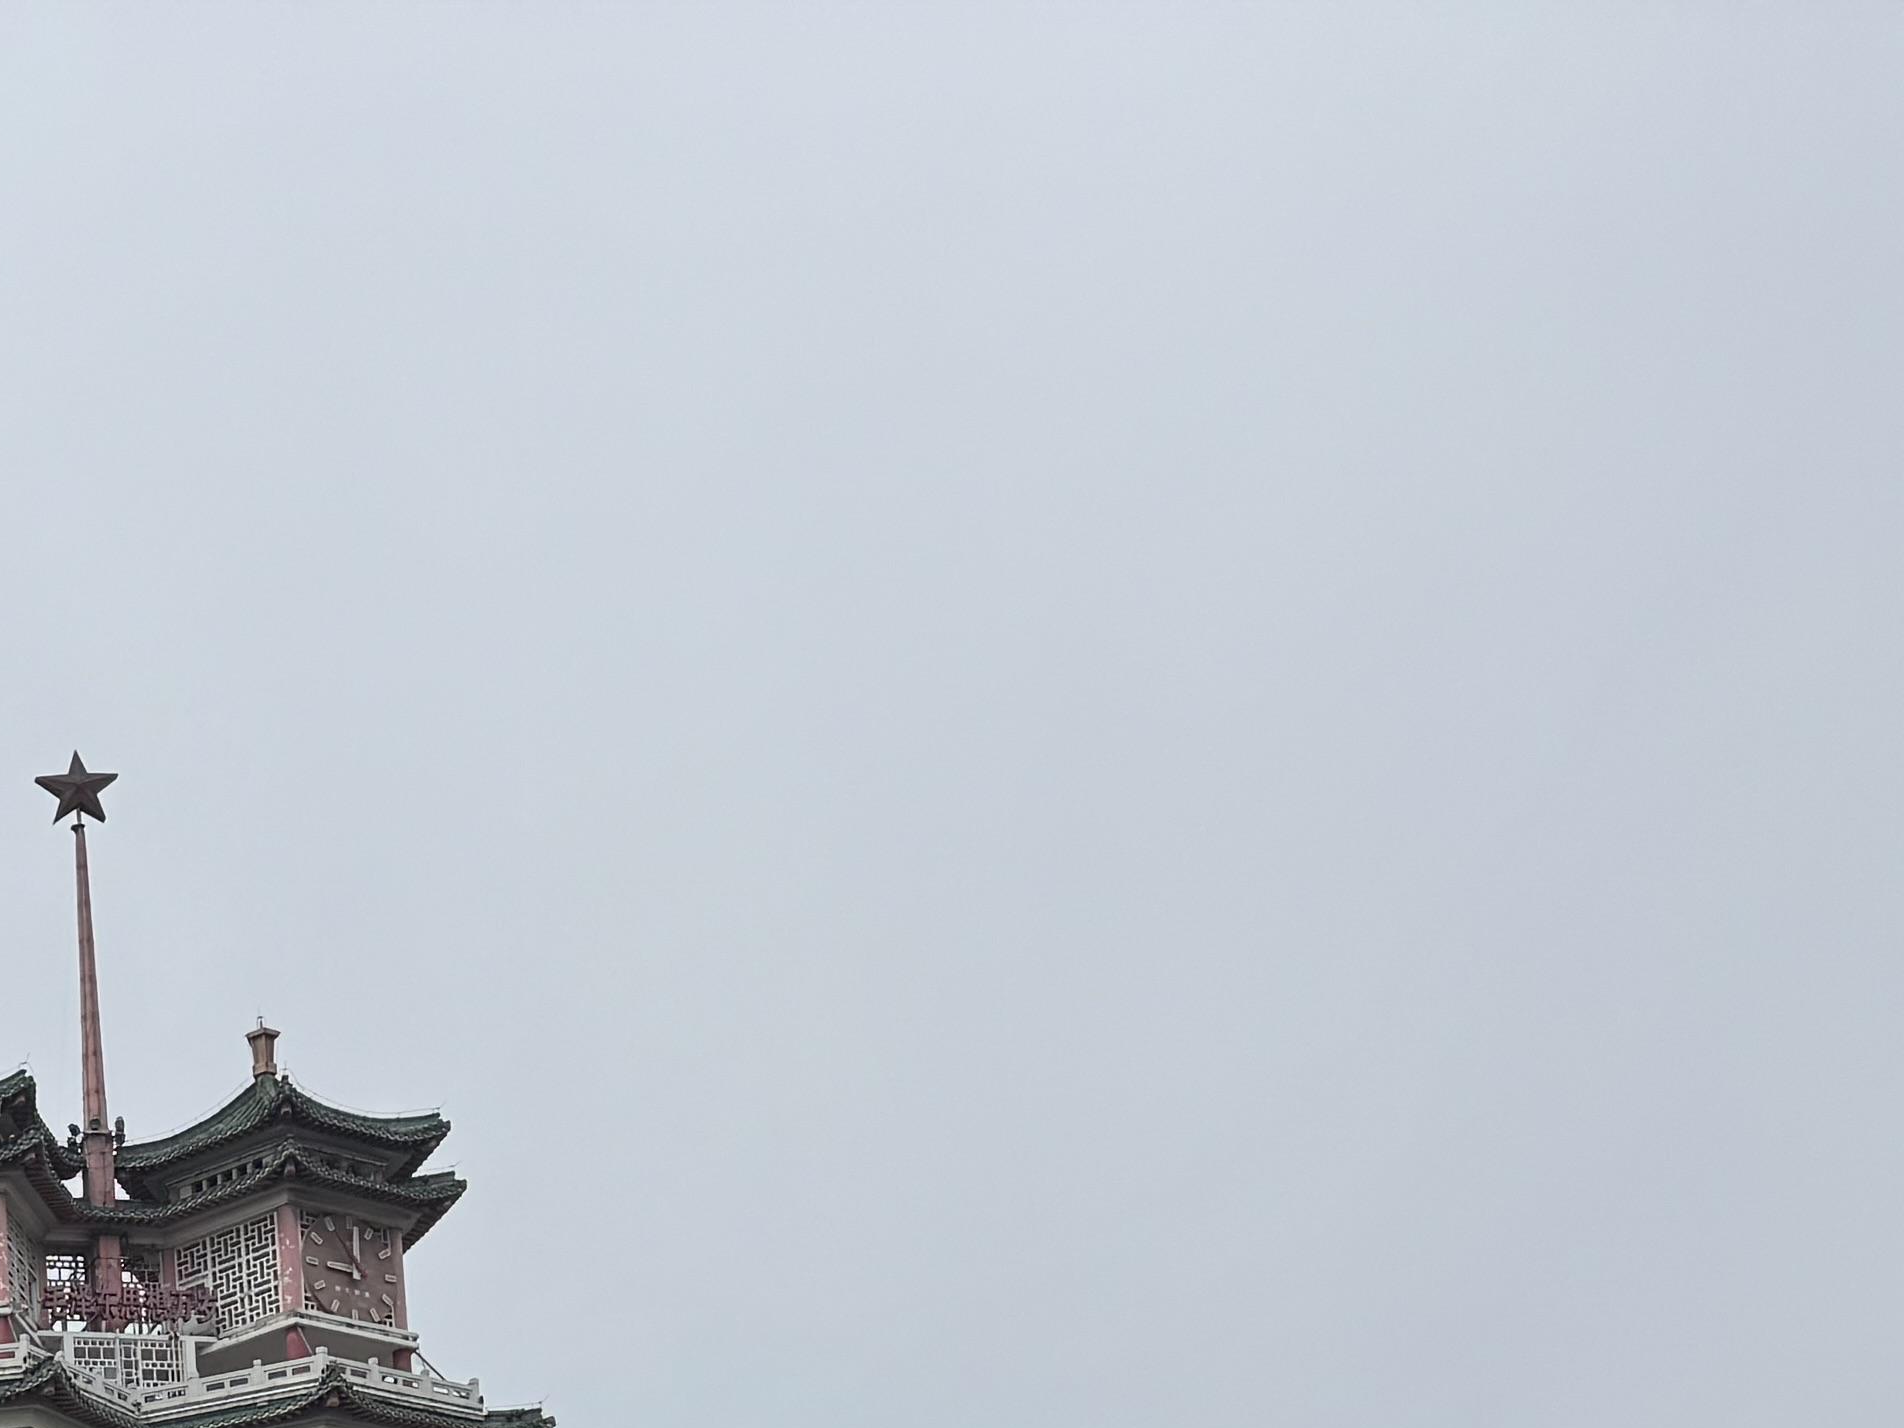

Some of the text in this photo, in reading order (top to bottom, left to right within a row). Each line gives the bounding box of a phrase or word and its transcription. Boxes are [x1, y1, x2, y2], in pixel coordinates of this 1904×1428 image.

[43, 1277, 218, 1325] 毛泽东思想万岁
